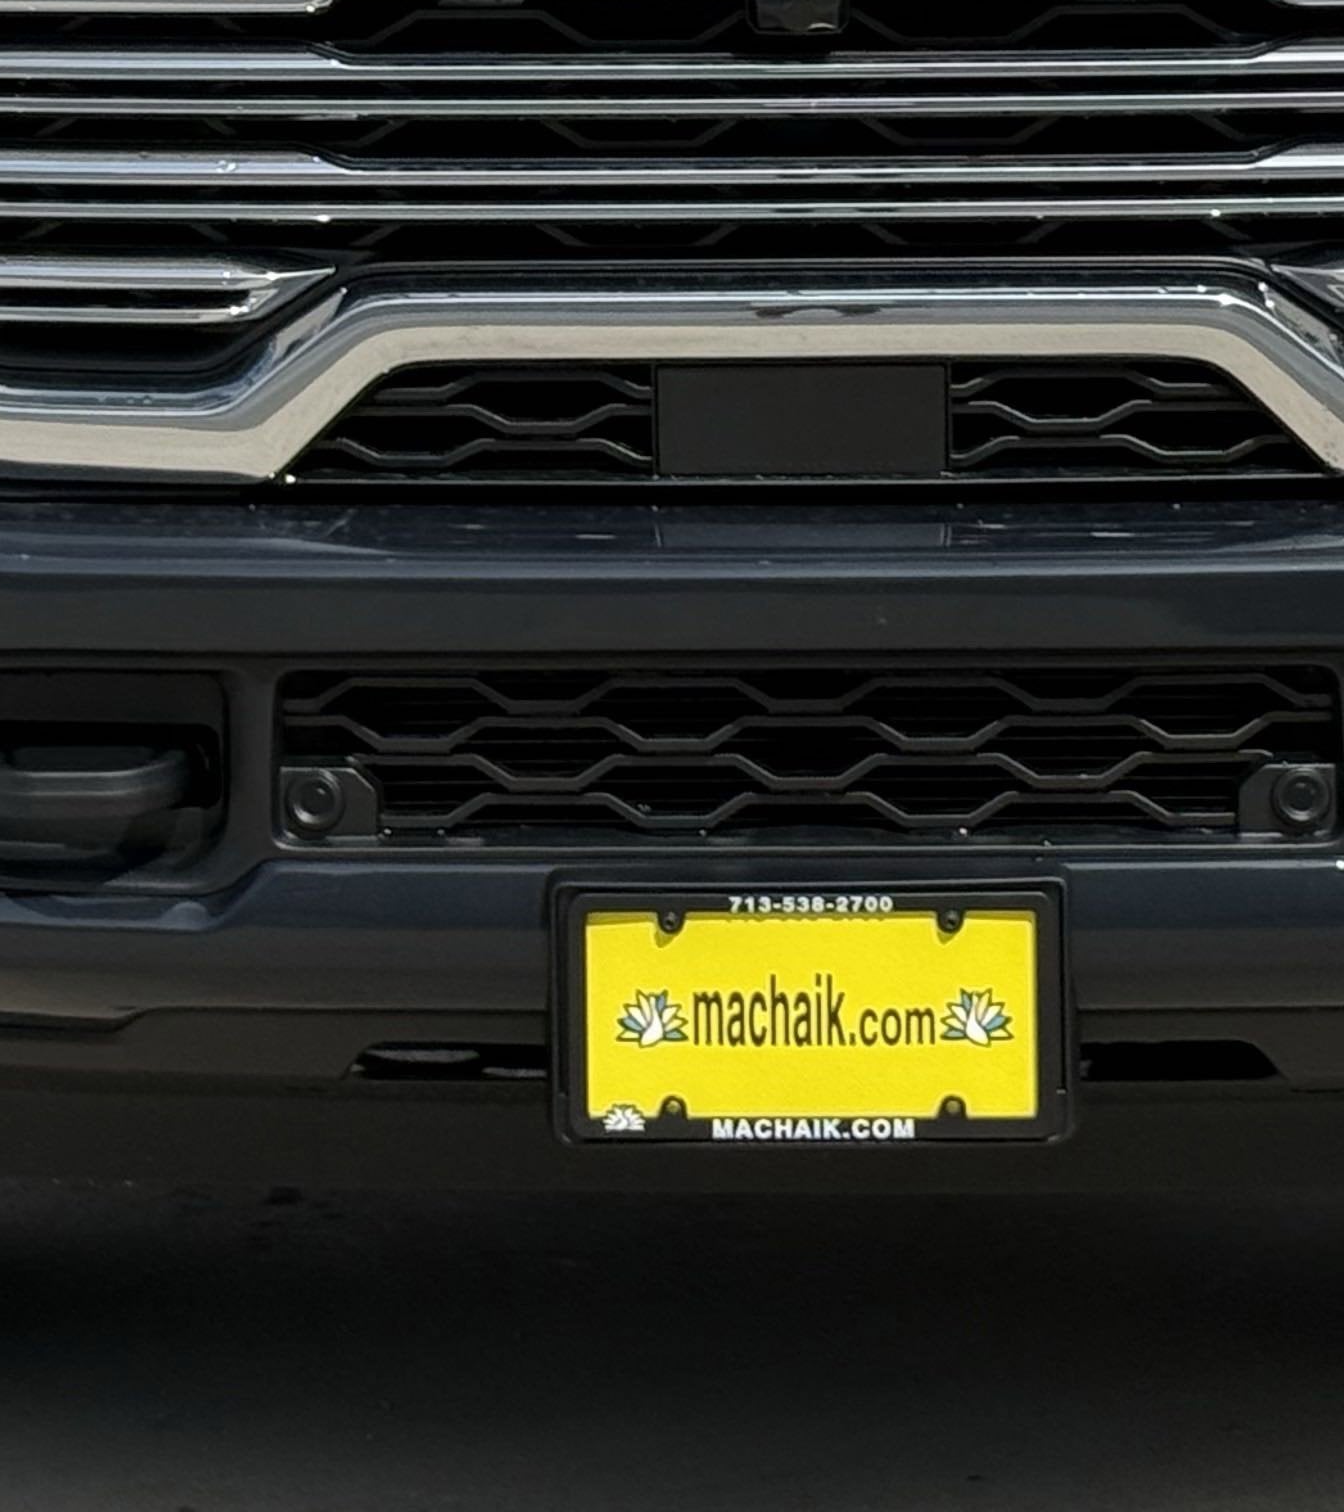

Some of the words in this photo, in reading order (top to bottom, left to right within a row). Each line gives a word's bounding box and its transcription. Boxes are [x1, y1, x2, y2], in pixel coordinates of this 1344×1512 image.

[728, 896, 894, 914] 713-538-2700
[692, 973, 936, 1047] machaik.com
[711, 1119, 916, 1140] MACHAIK.COM
